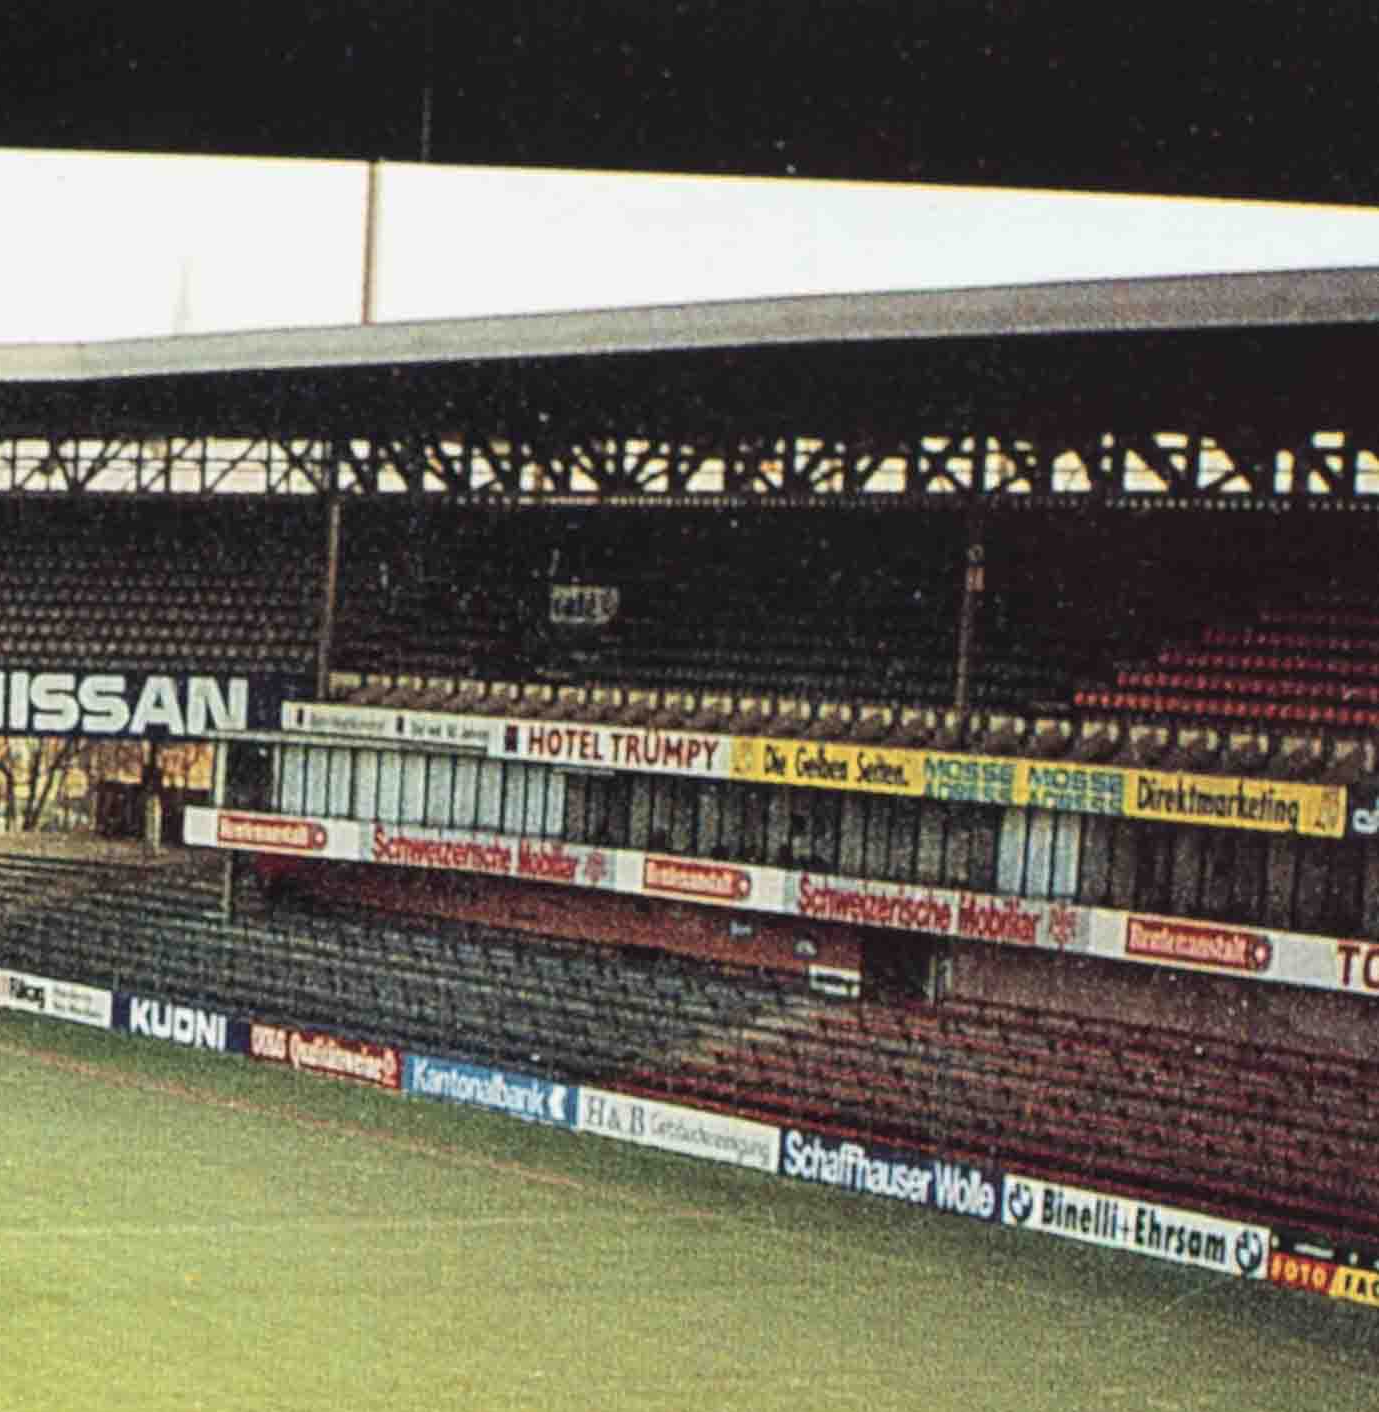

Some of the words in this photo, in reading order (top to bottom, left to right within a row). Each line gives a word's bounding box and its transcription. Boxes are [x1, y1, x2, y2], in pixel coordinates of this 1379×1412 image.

[527, 728, 604, 762] HOTEL
[1136, 774, 1300, 827] Direktmarketing
[373, 824, 512, 874] Schweizerische
[797, 872, 953, 930] Schweizerische
[129, 998, 226, 1050] KUONI
[411, 1059, 542, 1120] Kantonalbank
[784, 1130, 932, 1203] Schaffhauser
[934, 1160, 994, 1219] Wolle
